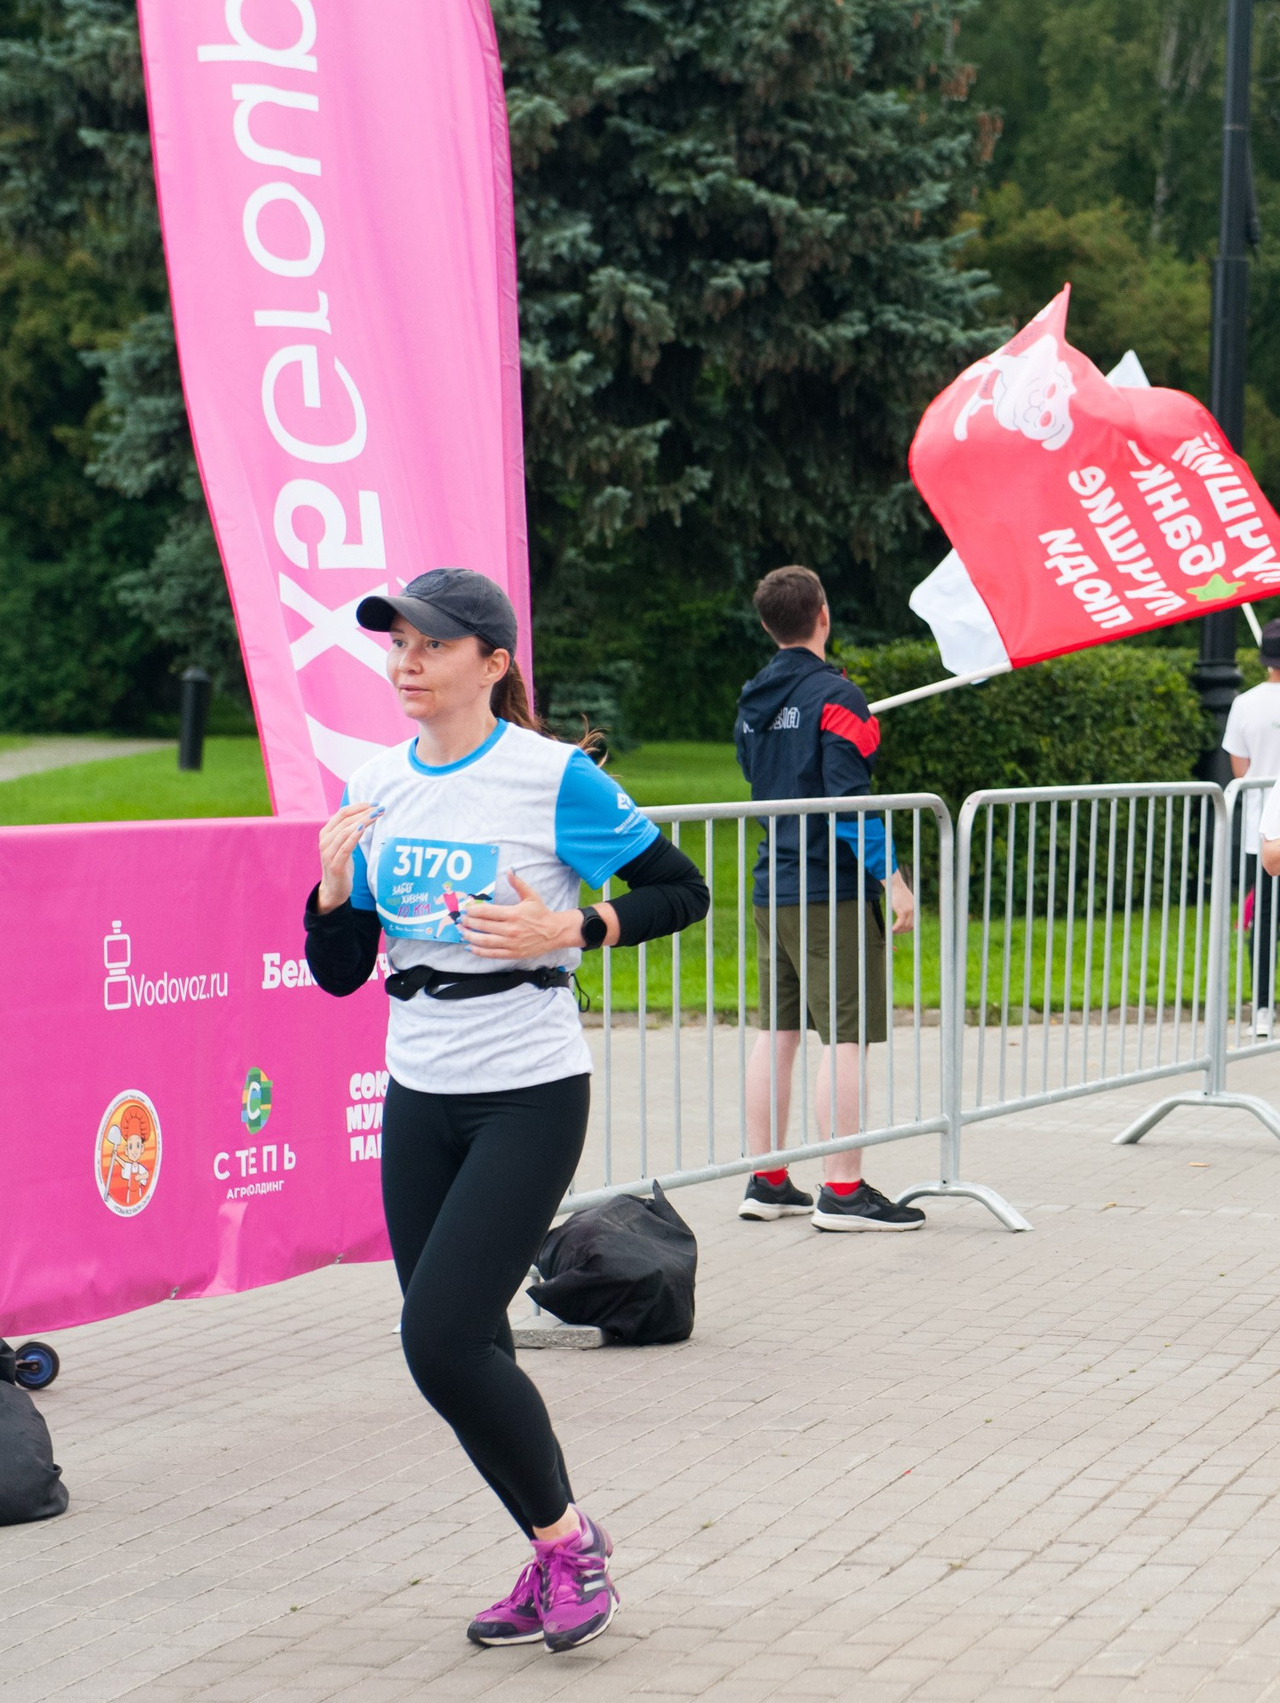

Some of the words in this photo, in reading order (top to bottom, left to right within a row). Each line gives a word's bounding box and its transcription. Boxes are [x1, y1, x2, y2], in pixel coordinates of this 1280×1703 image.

[393, 845, 472, 880] 3170
[262, 952, 318, 990] Бел
[131, 971, 228, 1007] Vodovoz.ru
[349, 1070, 390, 1101] СОЮ
[346, 1102, 383, 1133] МУЛ
[213, 1143, 296, 1180] СТЕПЬ
[350, 1133, 382, 1162] ПА
